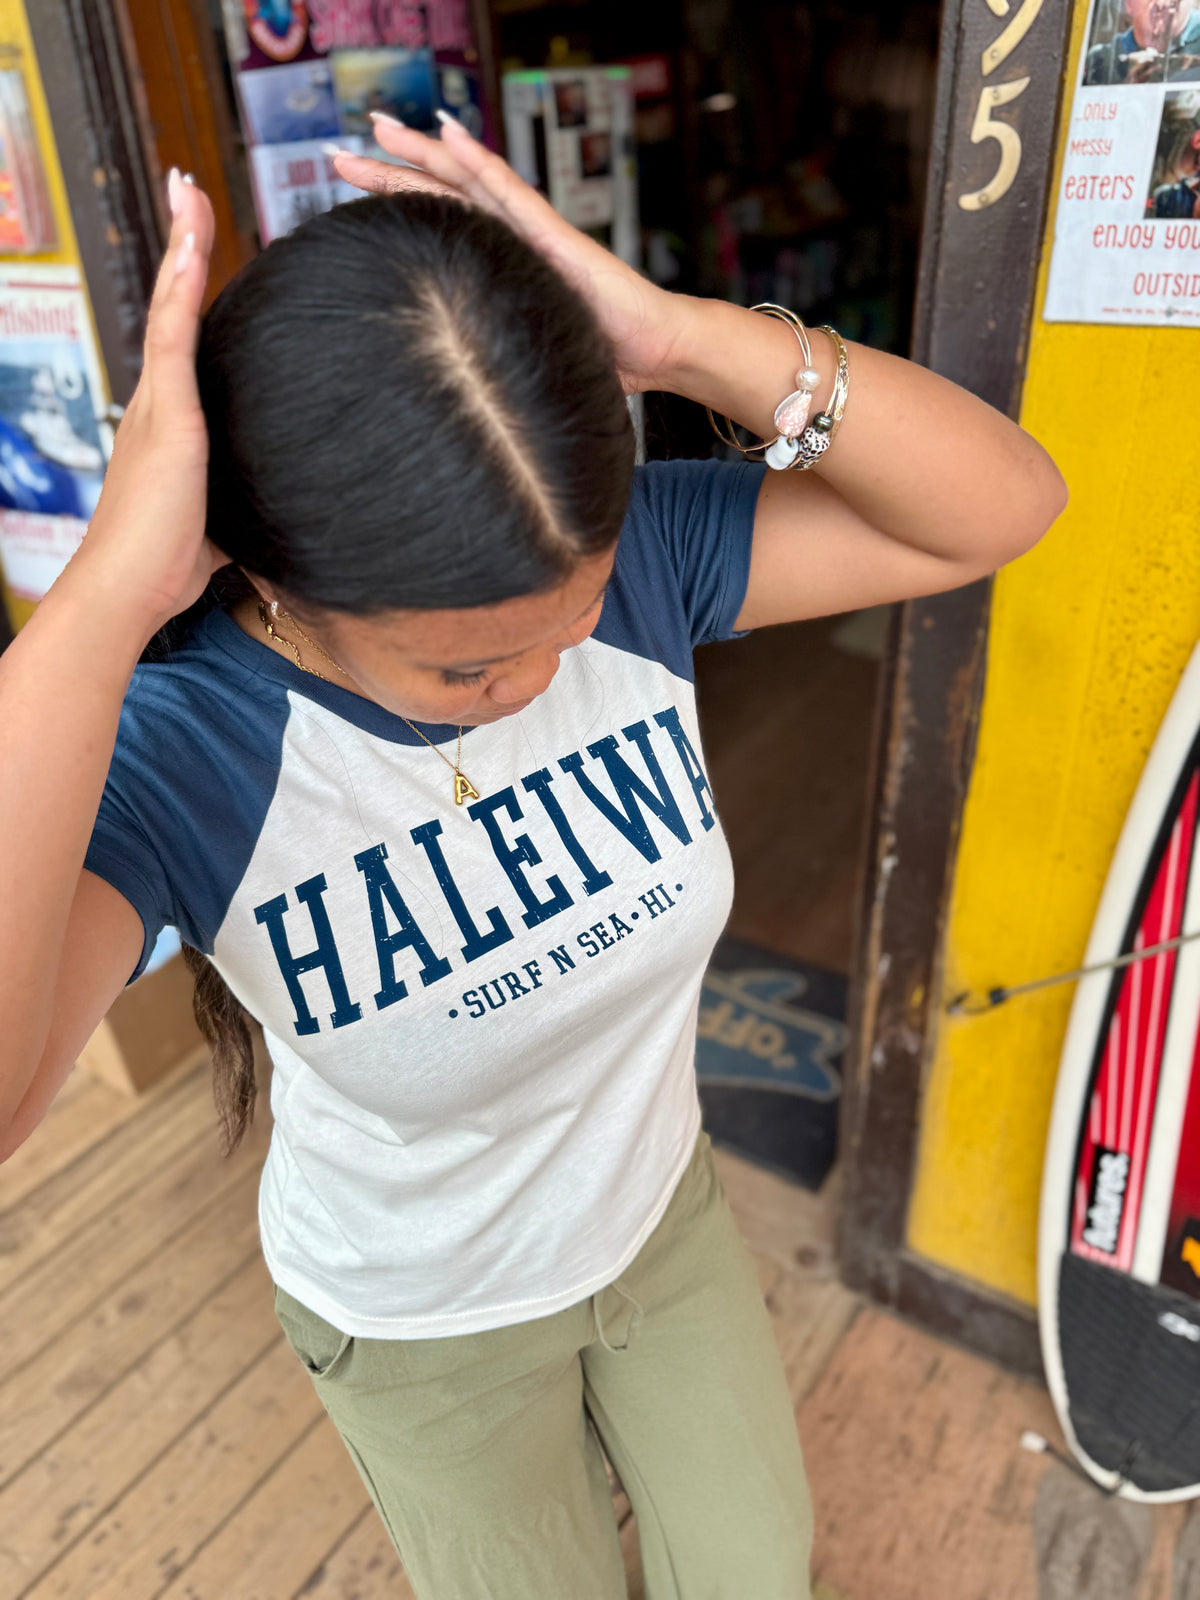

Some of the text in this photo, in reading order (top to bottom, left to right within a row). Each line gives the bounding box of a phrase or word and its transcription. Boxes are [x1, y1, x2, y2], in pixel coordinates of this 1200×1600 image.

[1093, 224, 1155, 249] enjoy
[454, 773, 479, 806] A
[254, 705, 717, 1036] HALEIWA
[462, 960, 543, 1018] SURF
[547, 944, 576, 975] N
